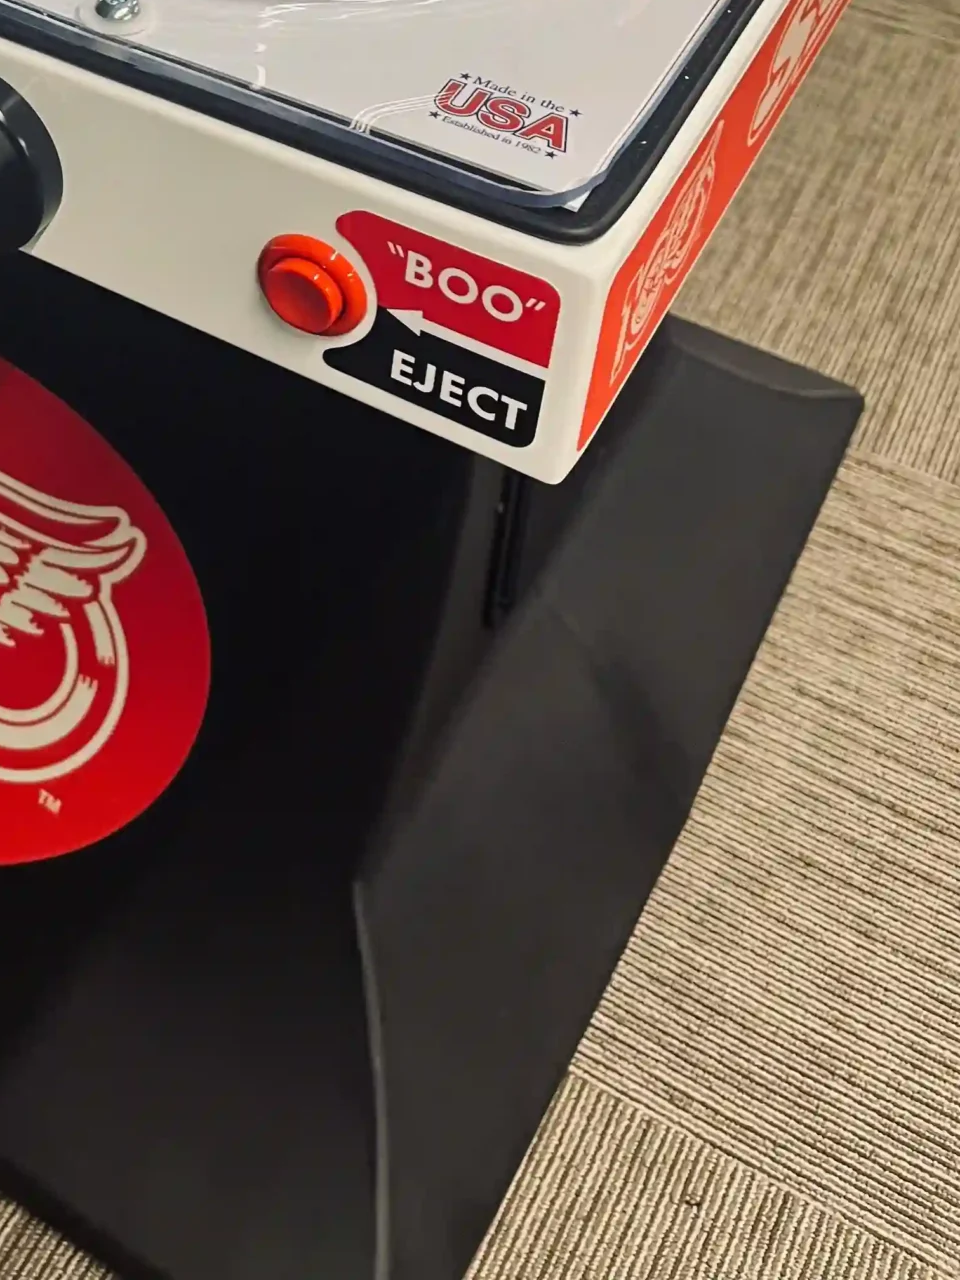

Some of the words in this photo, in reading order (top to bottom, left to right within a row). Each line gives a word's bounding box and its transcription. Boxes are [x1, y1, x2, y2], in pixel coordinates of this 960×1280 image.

[472, 76, 517, 97] Made
[520, 91, 536, 104] in
[540, 99, 565, 113] the
[434, 78, 569, 153] USA
[442, 115, 501, 141] Established
[501, 136, 512, 145] in
[515, 138, 542, 155] 1982
[390, 348, 528, 431] EJECT
[38, 788, 62, 814] TM
